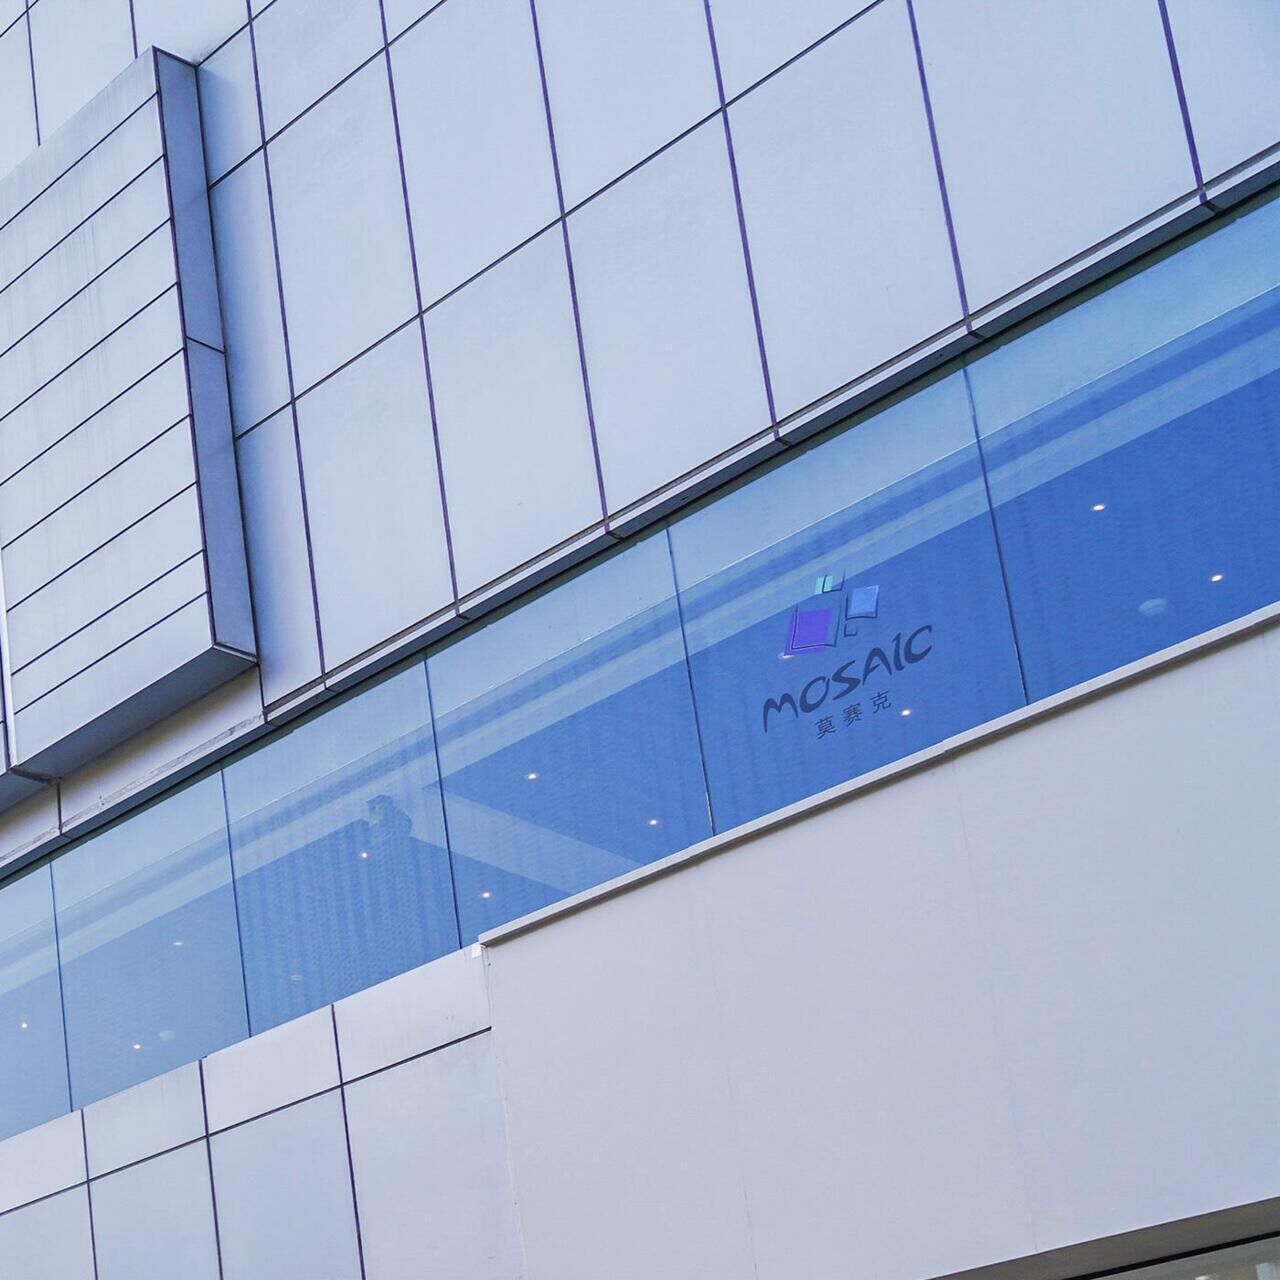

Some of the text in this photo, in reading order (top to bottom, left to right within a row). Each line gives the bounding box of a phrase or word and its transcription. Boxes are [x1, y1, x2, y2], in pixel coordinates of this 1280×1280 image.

[762, 624, 933, 733] MOSAIC
[815, 690, 892, 740] 莫赛克
